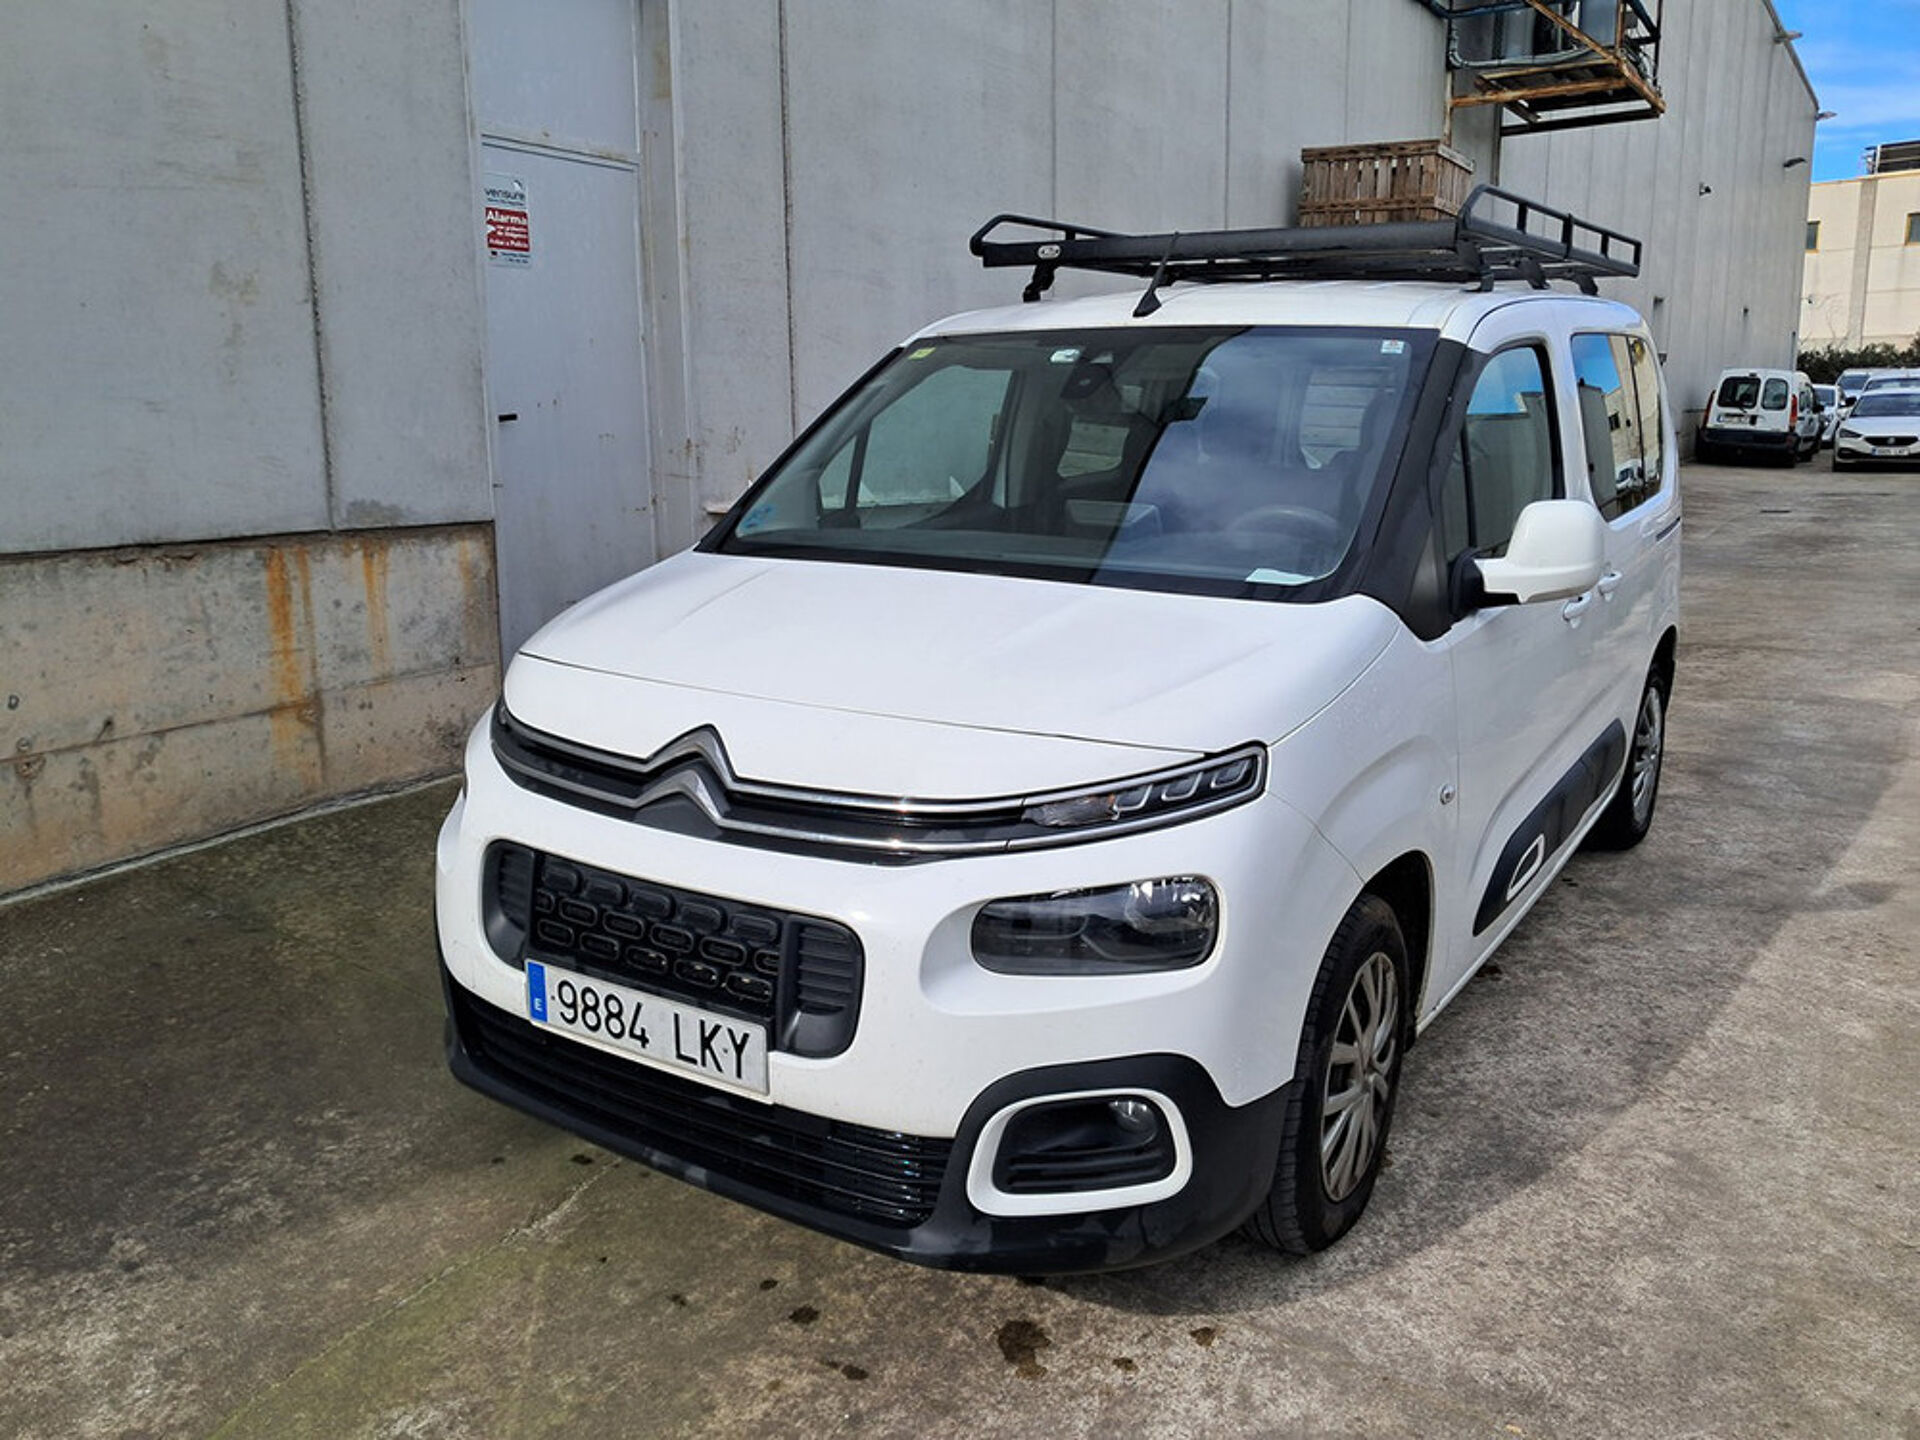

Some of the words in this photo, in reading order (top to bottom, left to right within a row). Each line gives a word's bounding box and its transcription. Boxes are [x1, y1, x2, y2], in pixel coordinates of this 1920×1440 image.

[484, 188, 525, 201] verisure
[487, 210, 526, 224] Alarma
[534, 998, 542, 1012] E
[557, 979, 650, 1049] 9884
[674, 1013, 751, 1079] LKY
